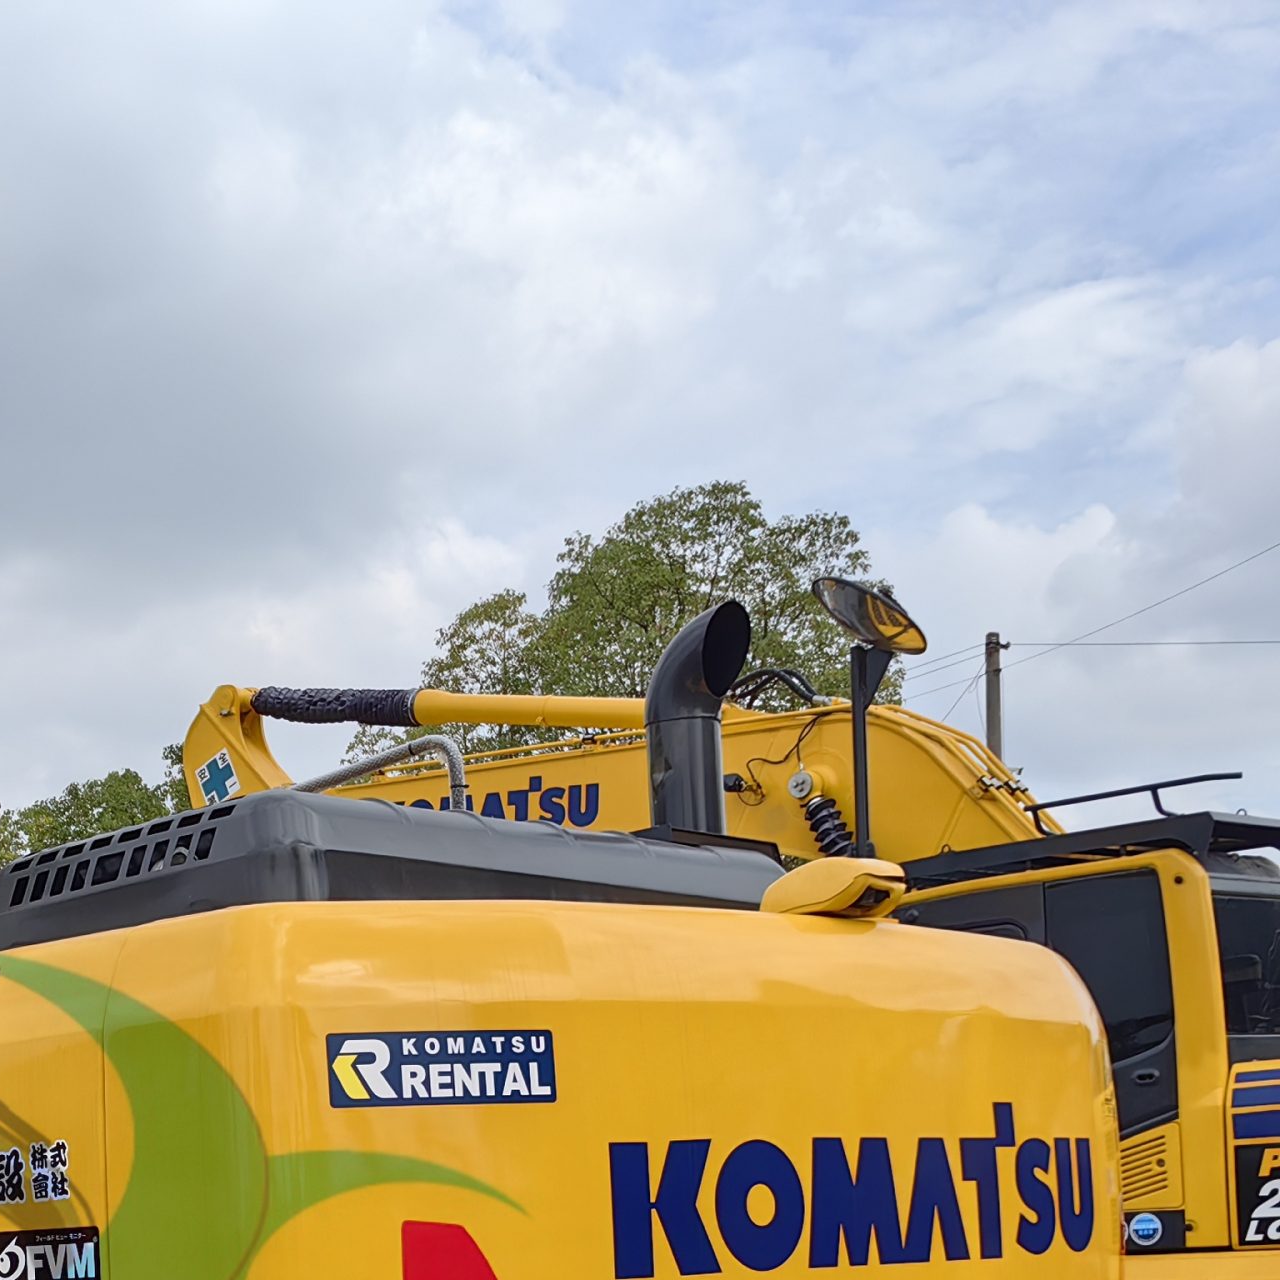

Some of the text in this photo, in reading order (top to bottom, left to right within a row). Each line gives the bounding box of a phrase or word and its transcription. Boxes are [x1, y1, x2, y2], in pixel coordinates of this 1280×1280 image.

[394, 776, 599, 827] ATSU
[401, 1036, 546, 1055] KOMATSU
[401, 1062, 552, 1098] RENTAL
[608, 1102, 1095, 1280] KOMATSU
[26, 1242, 95, 1280] FVM
